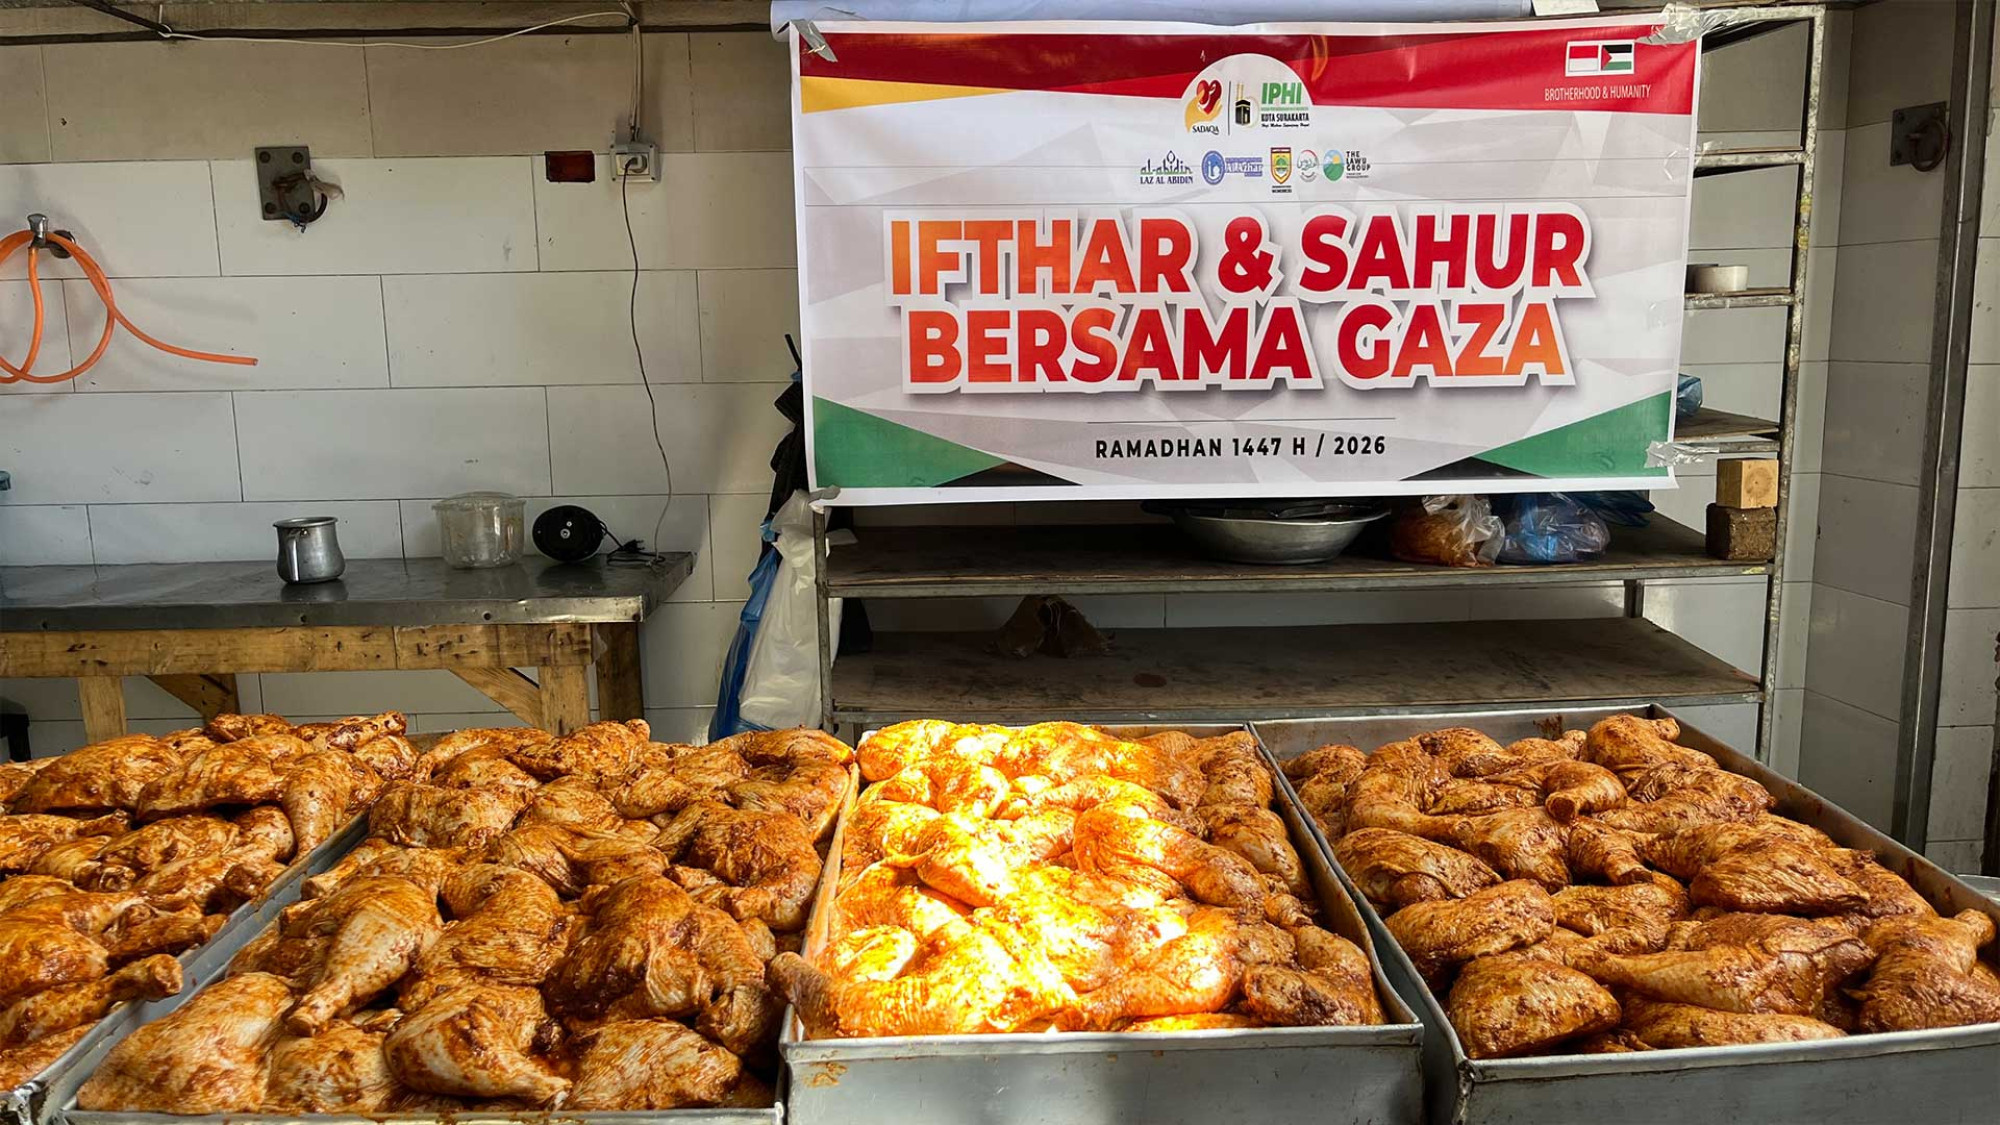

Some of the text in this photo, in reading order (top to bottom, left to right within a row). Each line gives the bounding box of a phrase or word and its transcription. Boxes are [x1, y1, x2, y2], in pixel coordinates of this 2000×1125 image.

[1261, 82, 1302, 105] IPHI
[1544, 84, 1651, 101] BROTHERHOOD & HUMANITY
[1261, 112, 1310, 122] KOTA SURAKARTA
[1192, 125, 1219, 135] SADAQA
[1140, 176, 1194, 185] LAZ AL ABIDIN
[890, 213, 1585, 295] IFTHAR & SAHUR
[908, 303, 1566, 383] BERSAMA GAZA
[1095, 433, 1386, 458] RAMADHAN 1447 H / 2026
